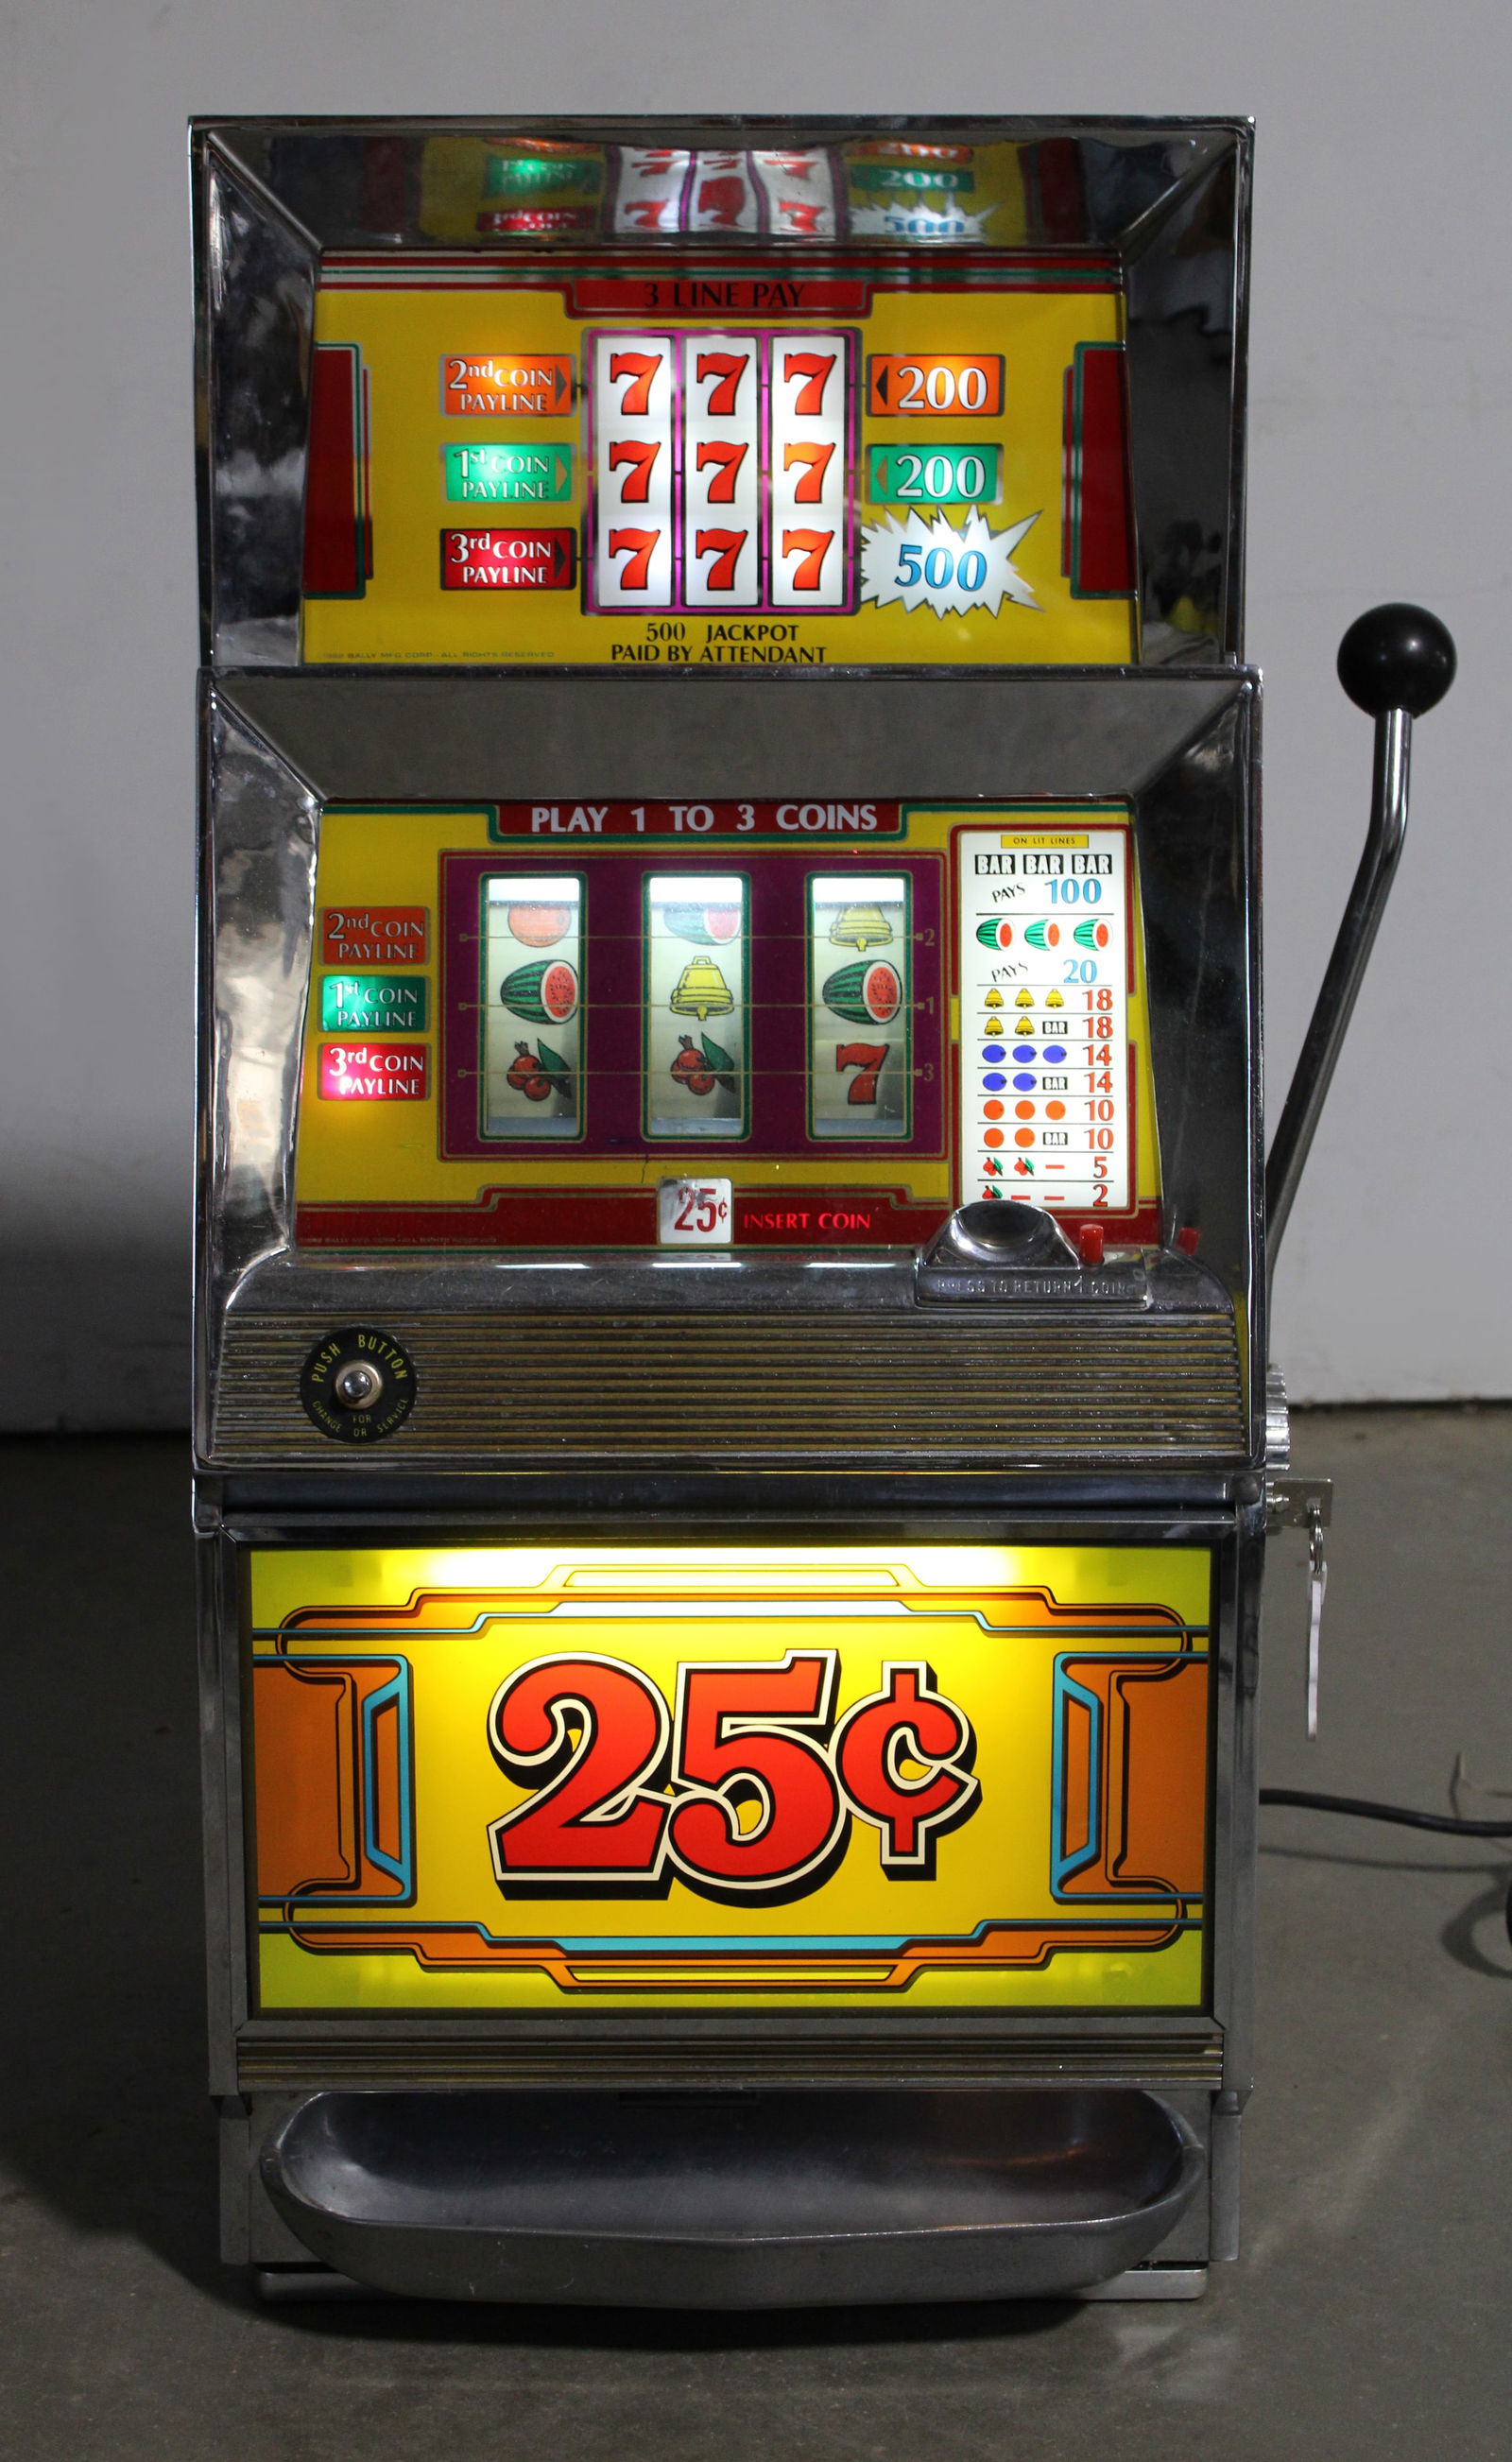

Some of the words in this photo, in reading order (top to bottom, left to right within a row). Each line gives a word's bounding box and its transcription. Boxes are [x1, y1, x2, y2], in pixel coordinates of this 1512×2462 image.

[644, 283, 660, 308] 3
[674, 283, 742, 308] LINE
[753, 283, 803, 308] PAY
[448, 358, 494, 390] 2nd
[493, 369, 553, 387] COIN
[610, 353, 663, 416] 7
[696, 353, 749, 416] 7
[783, 353, 836, 416] 7
[898, 366, 988, 410] 200
[460, 393, 547, 412] PAYLINE
[454, 448, 487, 479] 1st
[490, 456, 549, 473] COIN
[610, 440, 662, 503] 7
[696, 440, 749, 504] 7
[783, 441, 836, 504] 7
[897, 455, 986, 498] 200
[462, 481, 549, 499] PAYLINE
[450, 532, 491, 564] 3rd
[492, 541, 551, 559] COIN
[610, 527, 662, 590] 7
[696, 528, 748, 591] 7
[782, 528, 835, 591] 7
[462, 566, 548, 584] PAYLINE
[895, 543, 988, 592] 500
[645, 622, 686, 642] 500
[706, 625, 799, 644] JACKPOT
[611, 645, 661, 662] PAID
[667, 646, 693, 662] BY
[700, 646, 827, 663] ATTENDANT
[532, 806, 609, 833] PLAY
[630, 806, 644, 832] 1
[669, 804, 714, 832] TO
[736, 803, 755, 832] 3
[776, 803, 878, 831] COINS
[977, 854, 1014, 874] BAR
[1025, 854, 1062, 874] BAR
[1074, 854, 1110, 874] BAR
[992, 882, 1026, 904] PAYS
[1044, 878, 1102, 904] 100
[328, 912, 369, 940] 2nd
[370, 921, 424, 938] COIN
[924, 929, 936, 946] 2
[338, 943, 418, 959] PAYLINE
[991, 962, 1028, 983] PAYS
[1063, 959, 1098, 984] 20
[330, 981, 360, 1008] 1st
[364, 988, 418, 1004] COIN
[925, 996, 935, 1014] 1
[1082, 989, 1113, 1010] 18
[337, 1011, 416, 1027] PAYLINE
[1044, 1022, 1066, 1035] BAR
[1082, 1016, 1113, 1039] 18
[329, 1046, 368, 1076] 3rd
[369, 1055, 423, 1072] COIN
[1083, 1043, 1112, 1066] 14
[836, 1042, 890, 1105] 7
[924, 1062, 935, 1081] 3
[1044, 1077, 1066, 1090] BAR
[1084, 1071, 1113, 1093] 14
[339, 1077, 420, 1095] PAYLINE
[1084, 1099, 1114, 1121] 10
[1044, 1132, 1066, 1145] BAR
[1083, 1128, 1114, 1150] 10
[1093, 1156, 1108, 1179] 5
[1093, 1183, 1108, 1207] 2
[674, 1186, 728, 1232] 25¢
[744, 1213, 810, 1230] INSERT
[817, 1213, 871, 1230] COIN
[311, 1343, 341, 1383] PUSH
[358, 1334, 408, 1380] BUTTON
[312, 1401, 342, 1433] CHANGE
[352, 1414, 371, 1423] FOR
[487, 1648, 983, 1909] 25¢
